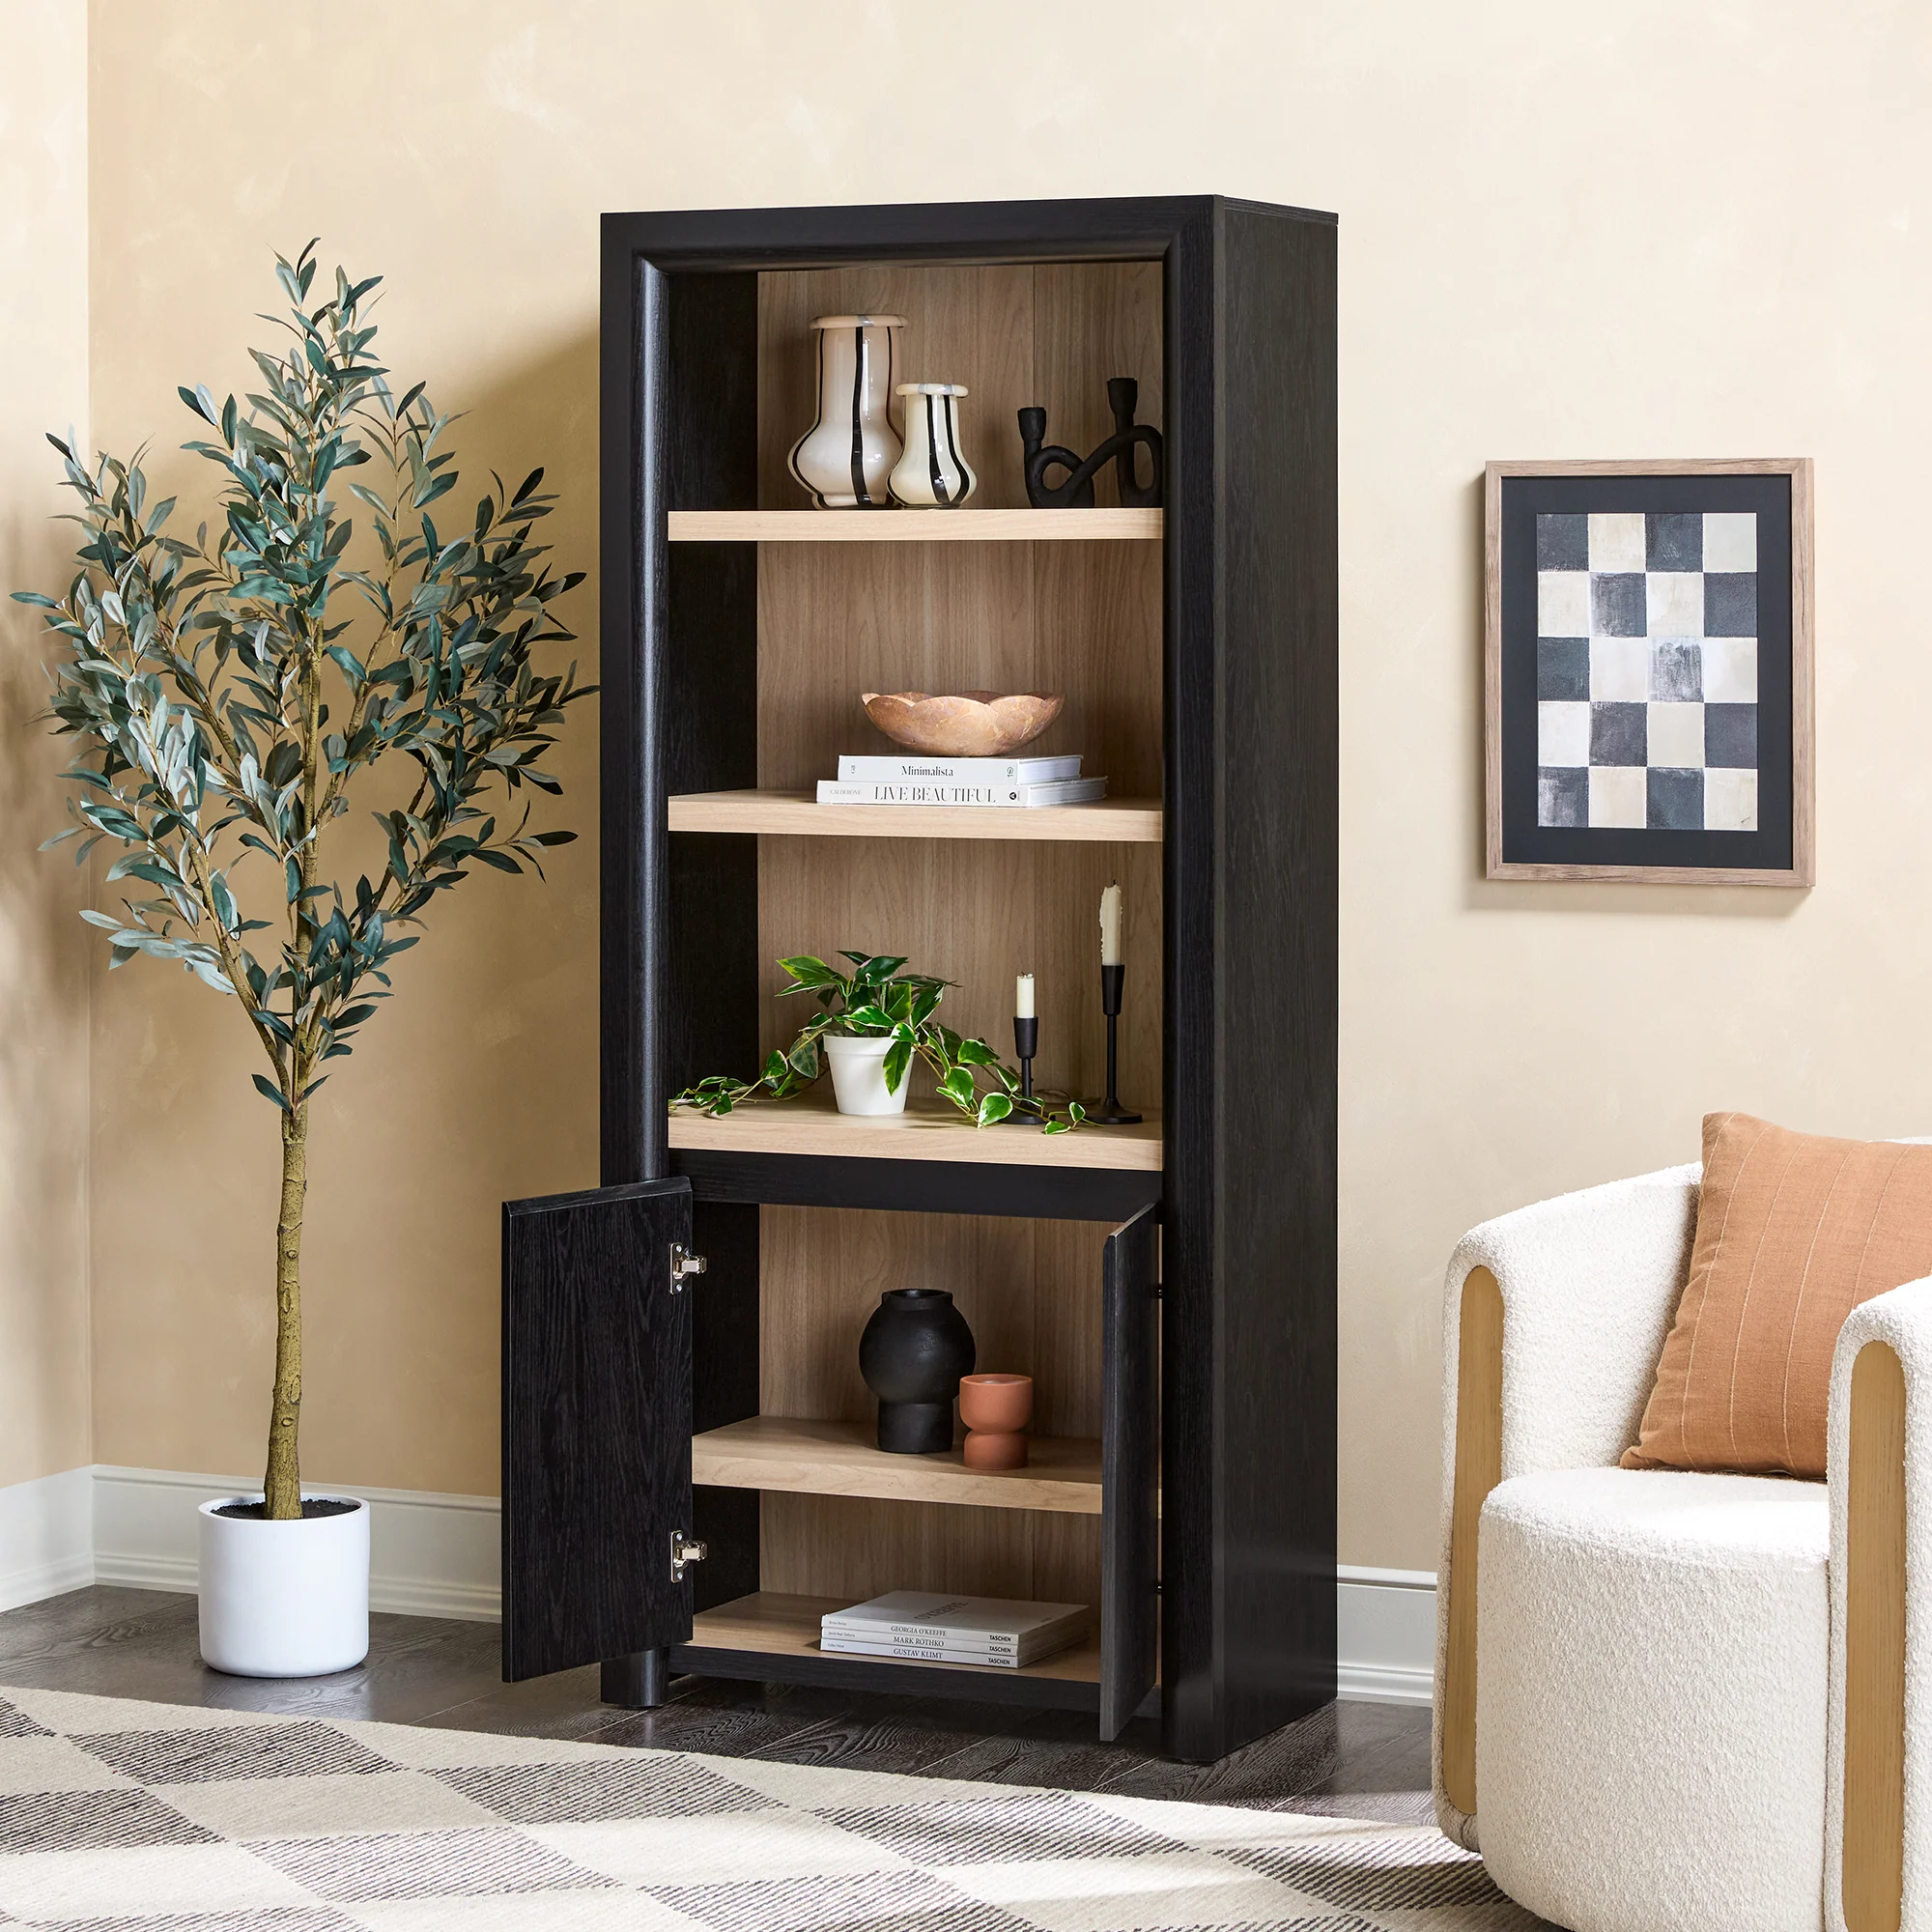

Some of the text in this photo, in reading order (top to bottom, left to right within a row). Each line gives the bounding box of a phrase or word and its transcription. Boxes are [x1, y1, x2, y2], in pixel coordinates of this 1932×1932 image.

[901, 765, 954, 777] Minimalista
[874, 786, 997, 804] LIVE BEAUTIFUL
[891, 1625, 948, 1637] GEORGIA O'KEEFFE
[893, 1635, 945, 1648] MARK ROTHKO
[893, 1648, 944, 1660] GUSTAV KLIMT
[989, 1645, 1011, 1654] TASCHEN
[987, 1657, 1010, 1665] TASCHEN
